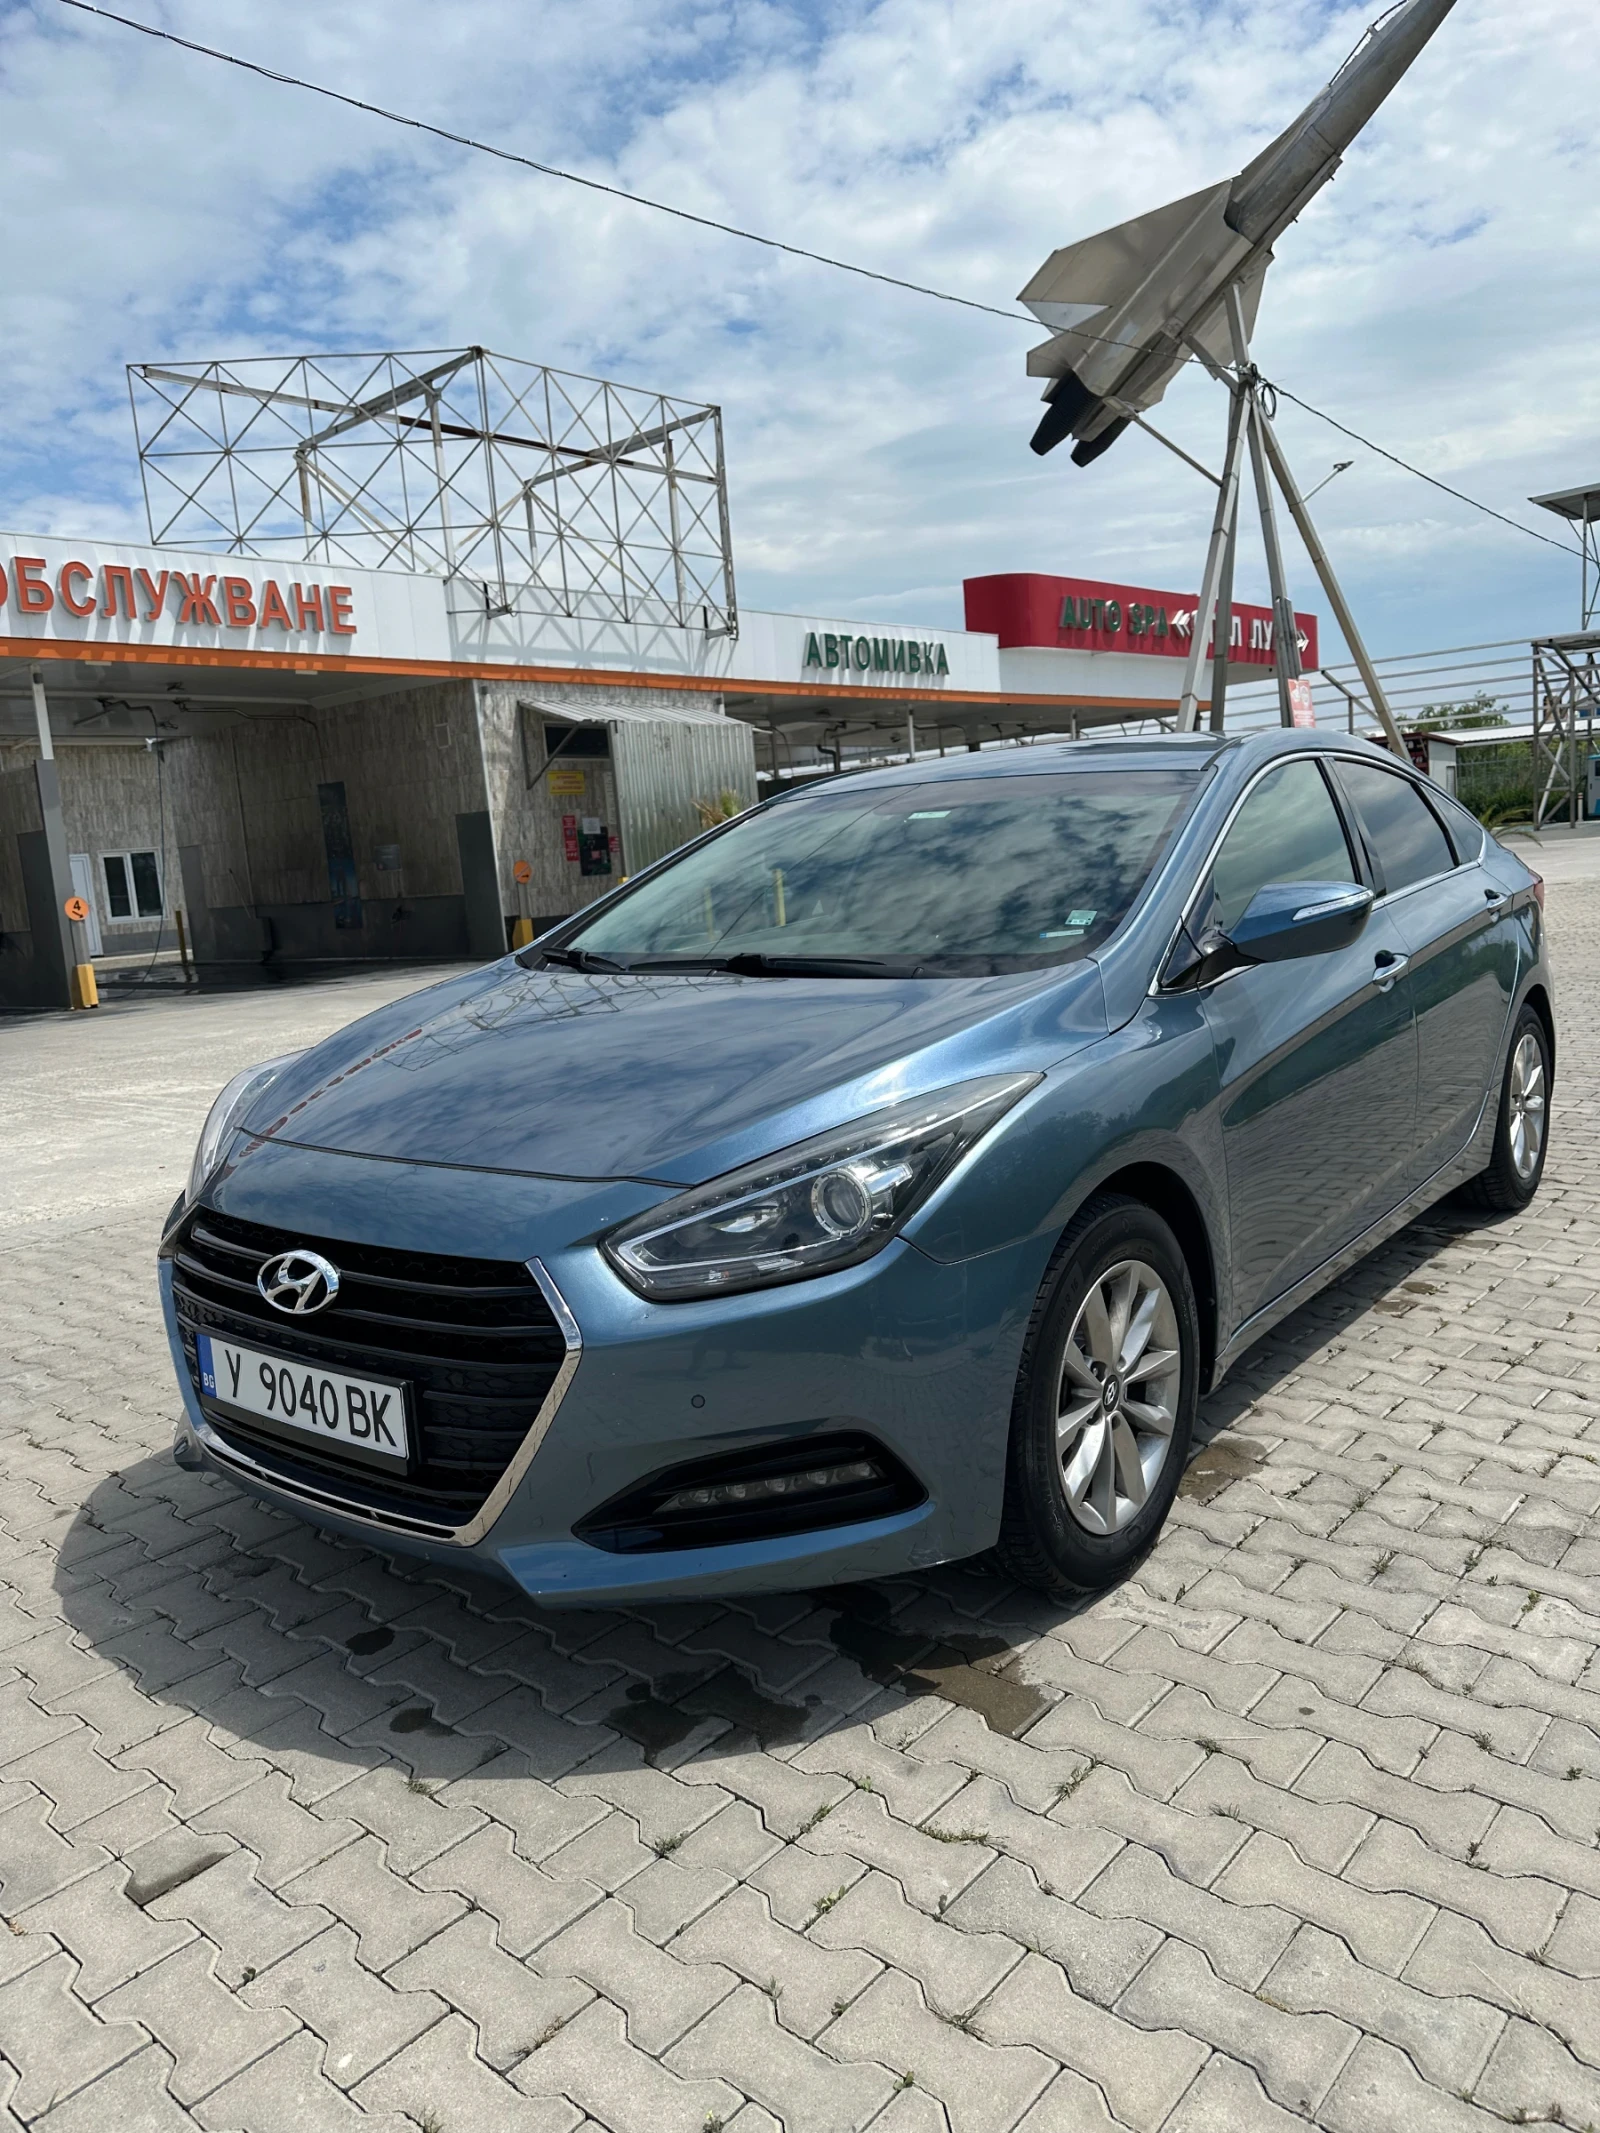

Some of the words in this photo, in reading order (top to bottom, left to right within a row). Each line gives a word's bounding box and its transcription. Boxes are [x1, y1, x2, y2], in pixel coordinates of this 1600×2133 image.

[0, 556, 357, 634] БСЛУЖВАНЕ
[1060, 595, 1121, 632] AUTO
[1128, 603, 1169, 635] SPA
[802, 632, 950, 675] АВТОМИВКА
[73, 900, 82, 911] 4
[203, 1372, 215, 1388] BG
